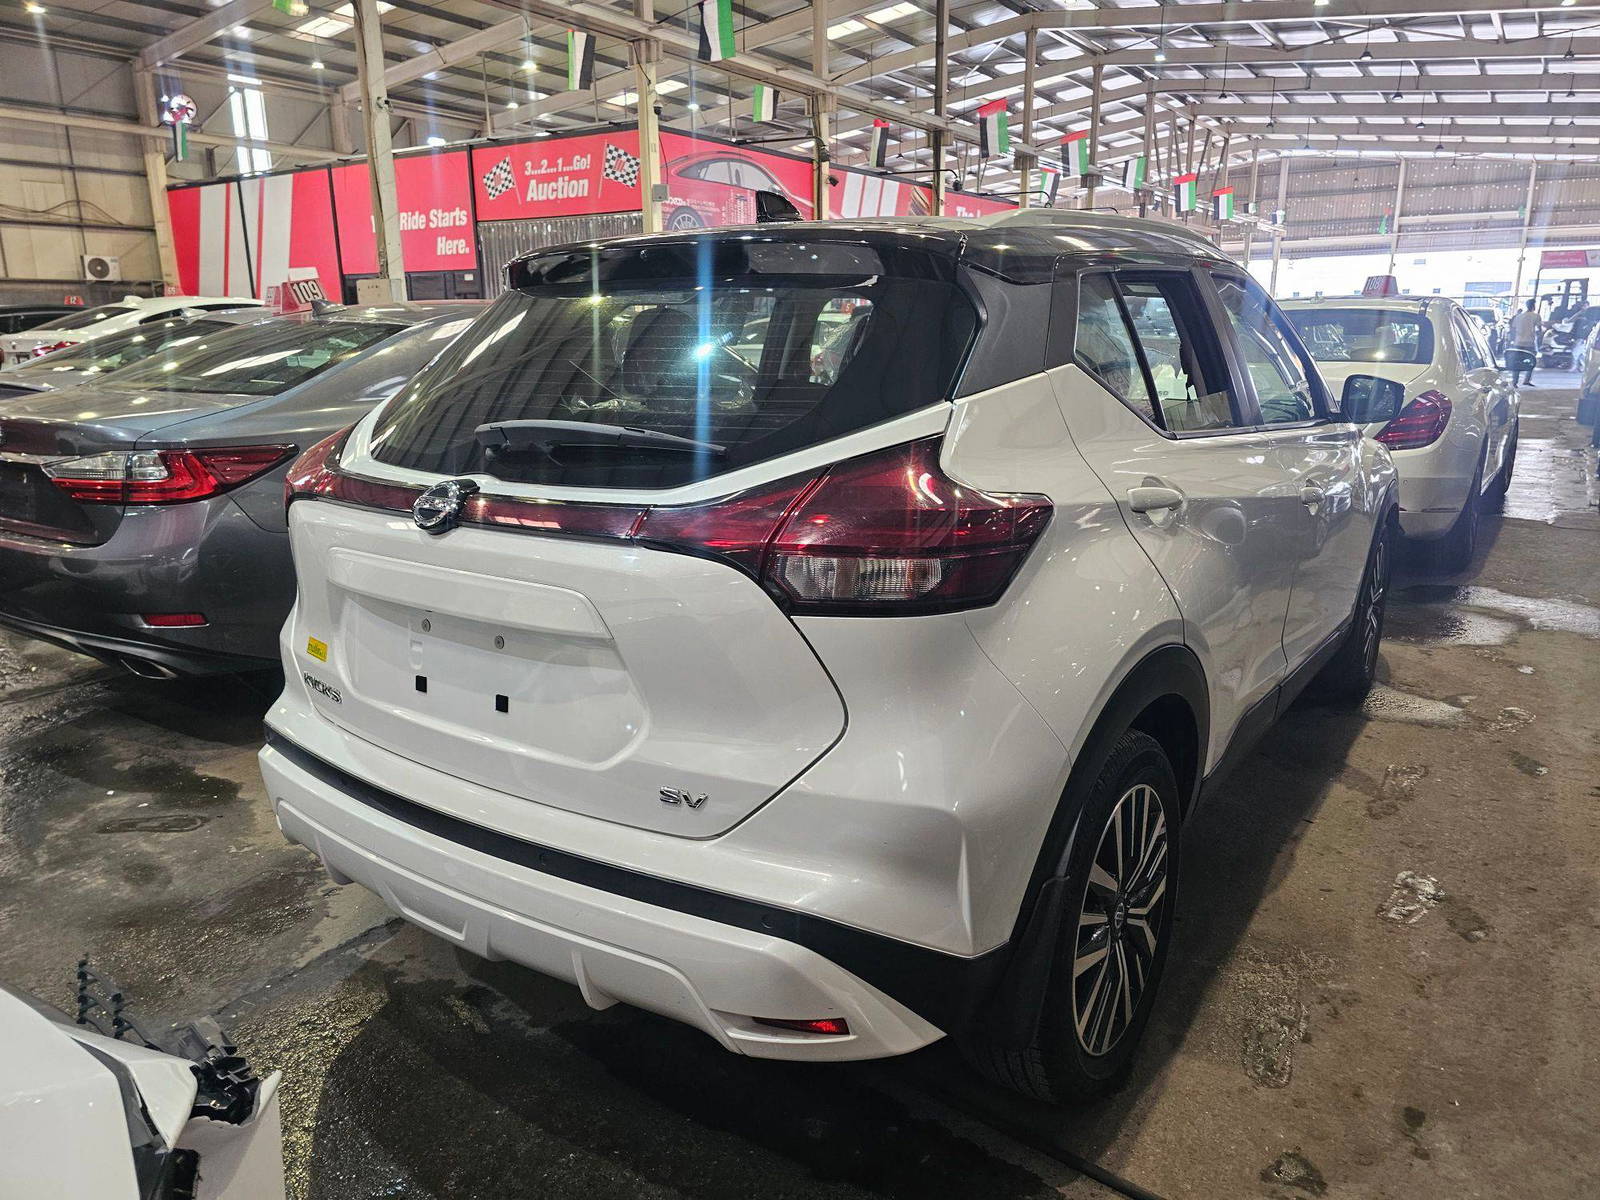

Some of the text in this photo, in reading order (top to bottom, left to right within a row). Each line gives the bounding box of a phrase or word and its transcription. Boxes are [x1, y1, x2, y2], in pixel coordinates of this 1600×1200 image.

[526, 176, 589, 202] Auction
[400, 210, 426, 231] Ride
[429, 207, 468, 229] Starts
[437, 236, 470, 256] Here.
[292, 279, 323, 304] 109
[659, 785, 708, 809] SV
